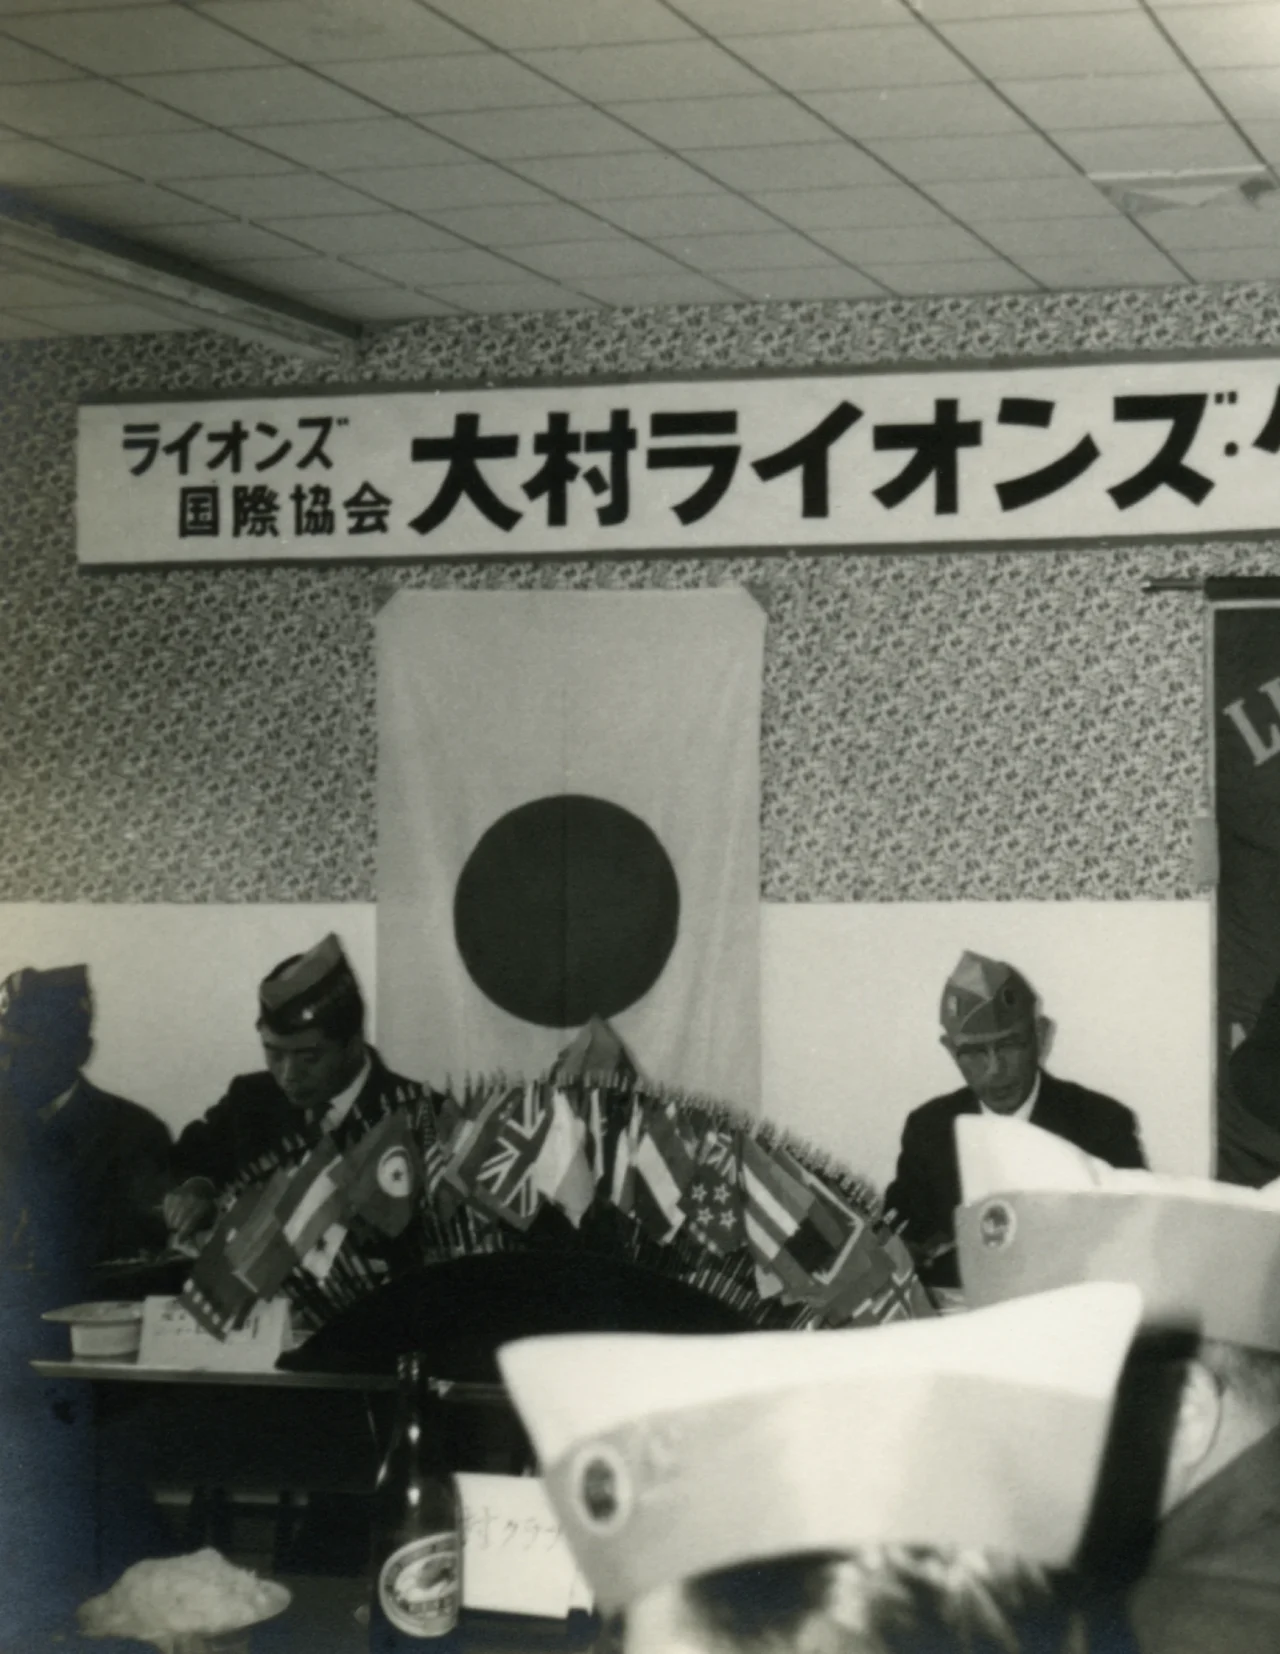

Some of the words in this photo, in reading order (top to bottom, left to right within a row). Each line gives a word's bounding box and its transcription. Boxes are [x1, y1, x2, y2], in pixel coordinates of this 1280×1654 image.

[121, 415, 350, 477] ライオンズ
[177, 480, 393, 538] 国際協会
